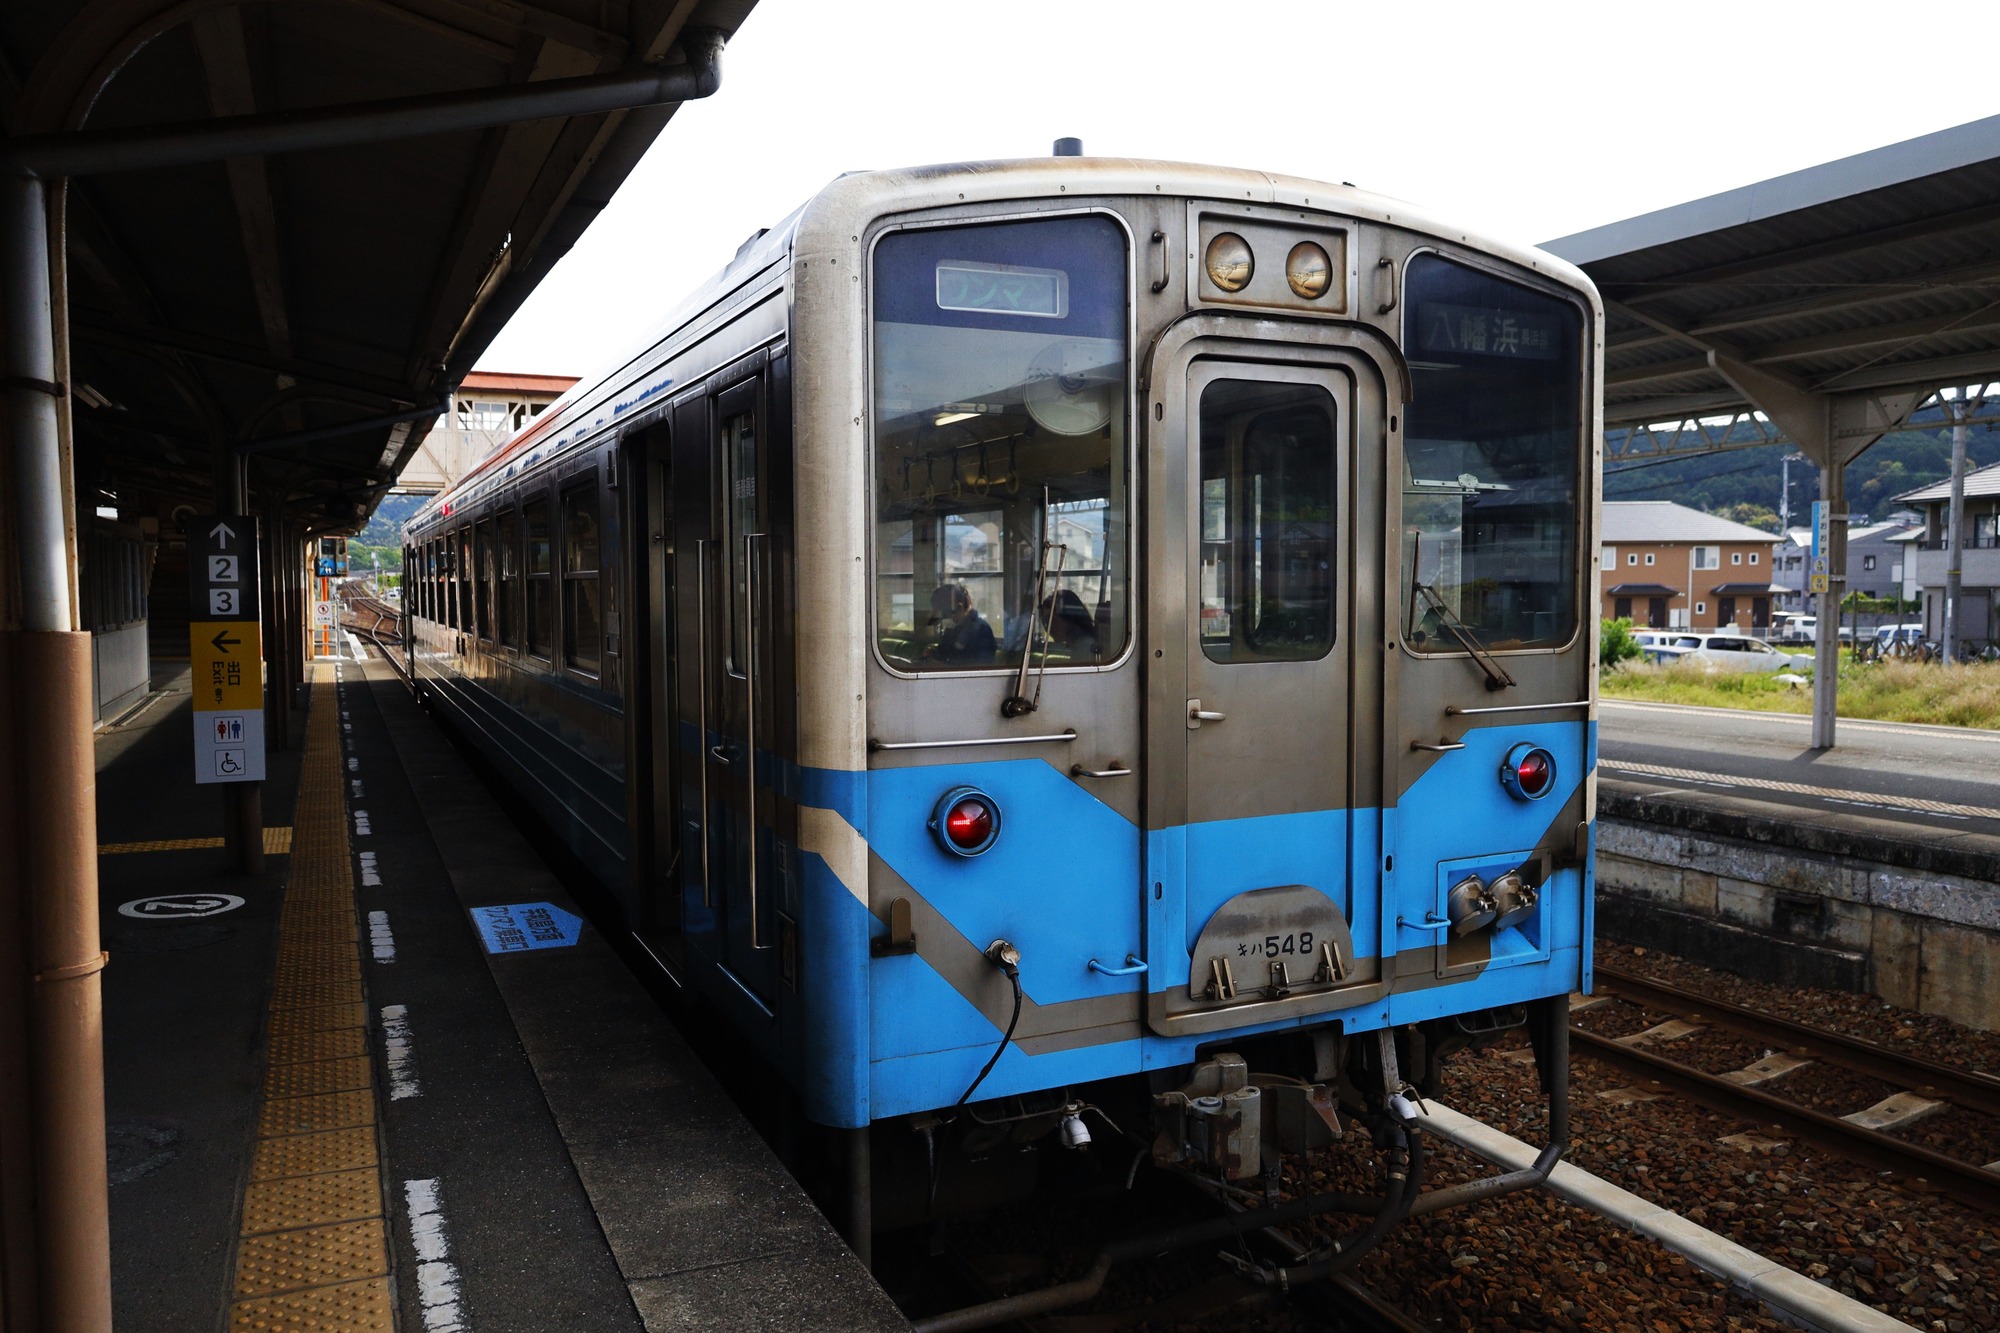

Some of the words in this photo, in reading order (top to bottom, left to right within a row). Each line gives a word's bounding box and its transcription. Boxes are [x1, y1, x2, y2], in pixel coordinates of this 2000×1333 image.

[1427, 312, 1519, 354] 八幡浜
[1820, 504, 1828, 554] いよおおず
[215, 557, 232, 579] 2
[216, 591, 233, 613] 3
[212, 661, 224, 685] Exit
[228, 661, 241, 686] 出口
[1237, 932, 1313, 958] キハ548
